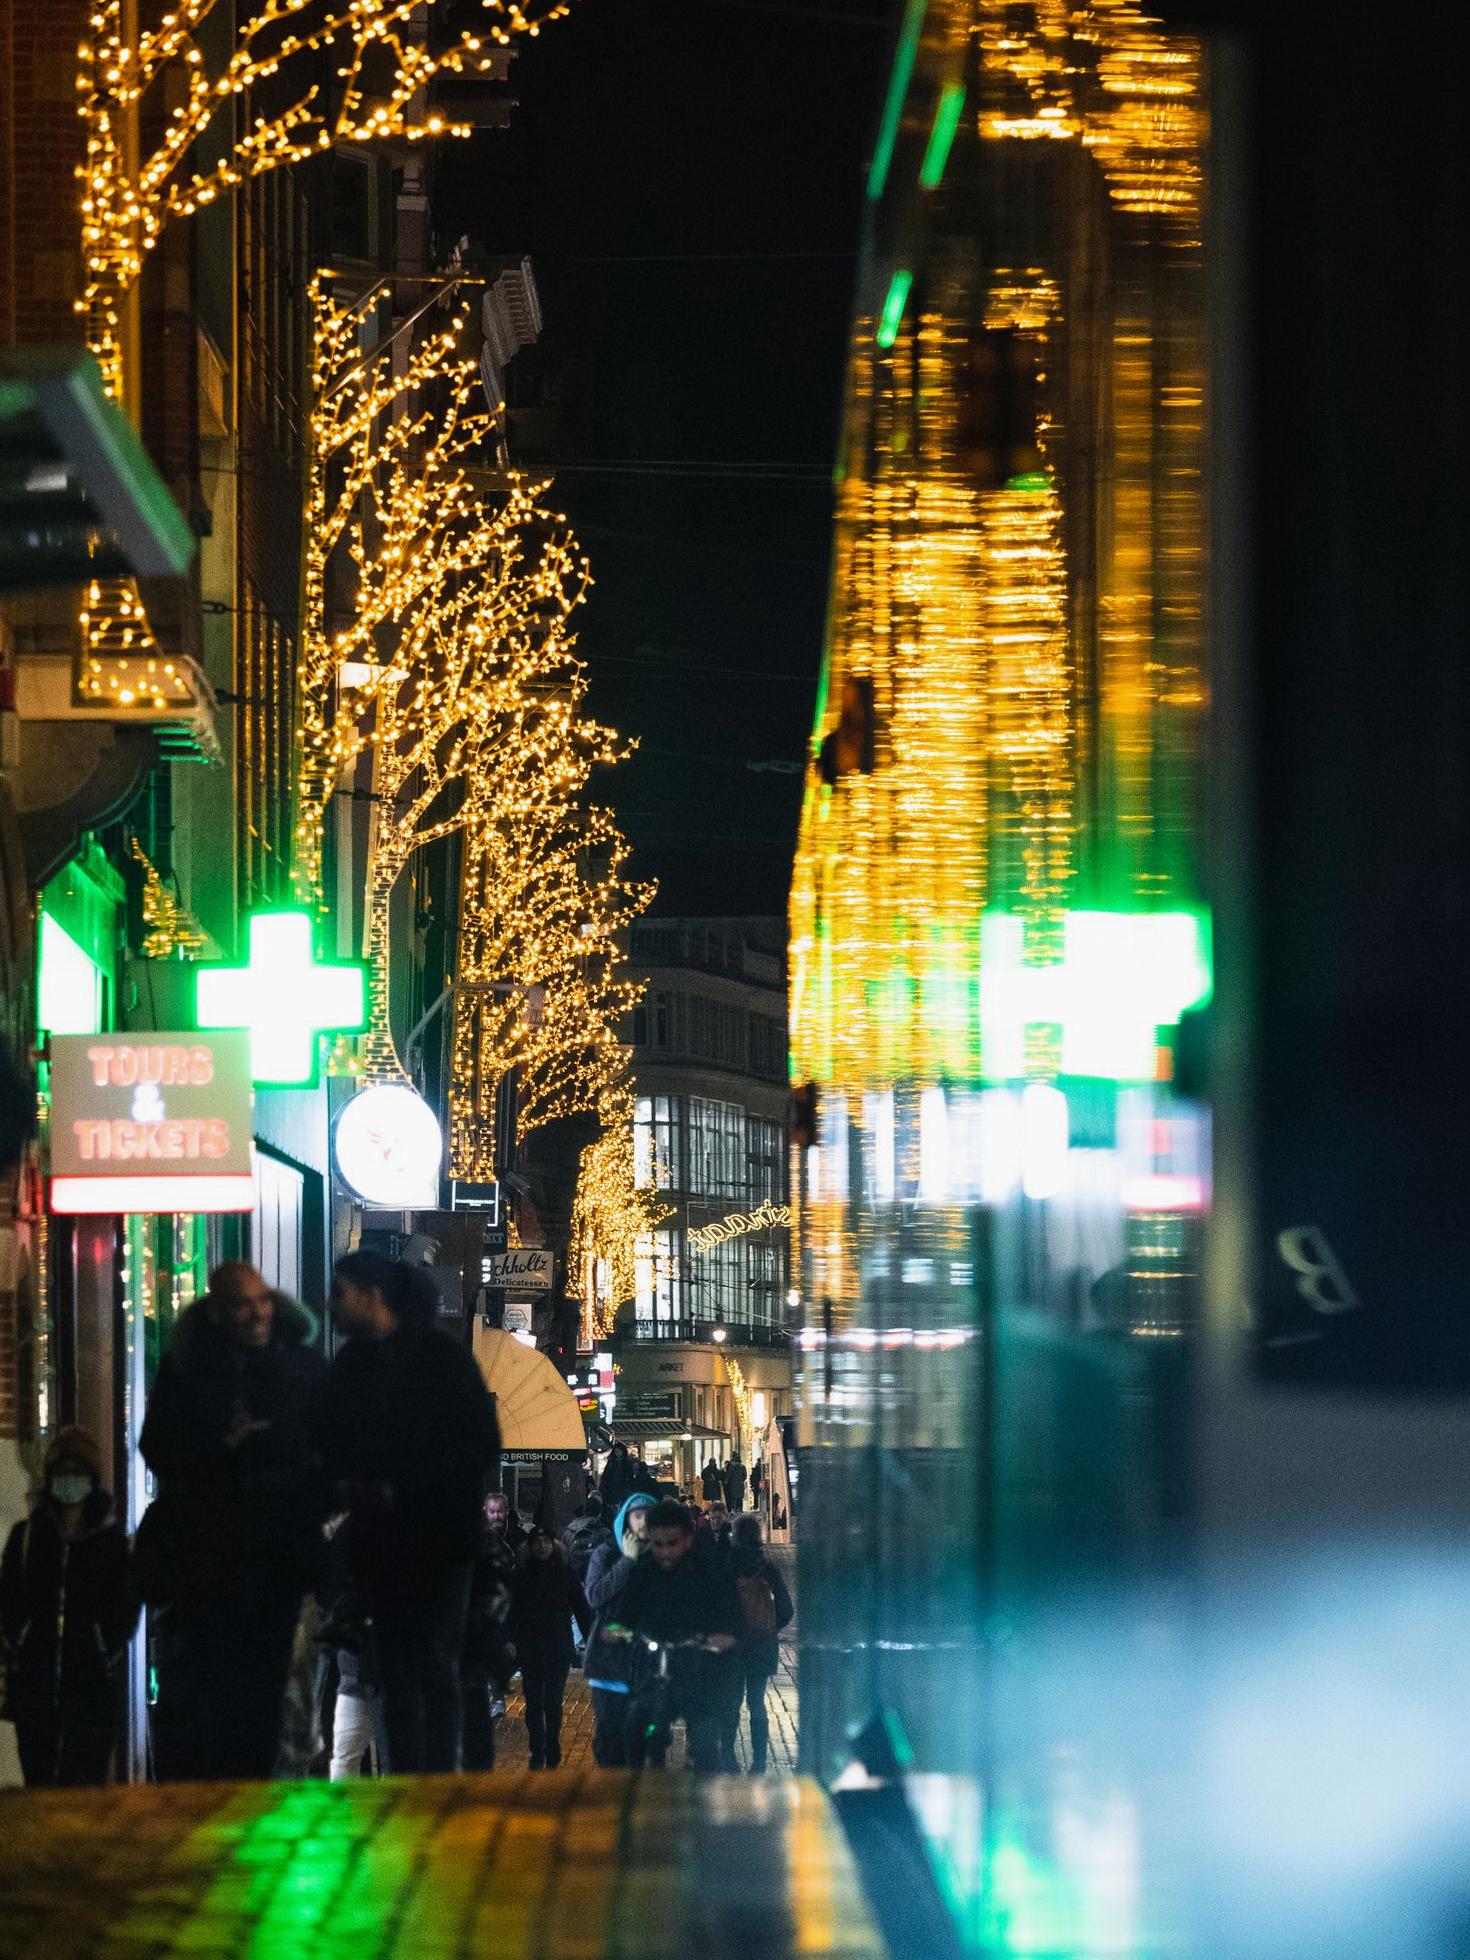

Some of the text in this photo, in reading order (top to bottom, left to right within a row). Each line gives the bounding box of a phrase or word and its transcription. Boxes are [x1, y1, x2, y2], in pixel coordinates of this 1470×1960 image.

[87, 1046, 215, 1087] TOURS
[131, 1083, 166, 1123] &
[73, 1118, 231, 1160] TICKETS
[511, 1453, 543, 1461] BRITISH
[545, 1453, 569, 1461] FOOD
